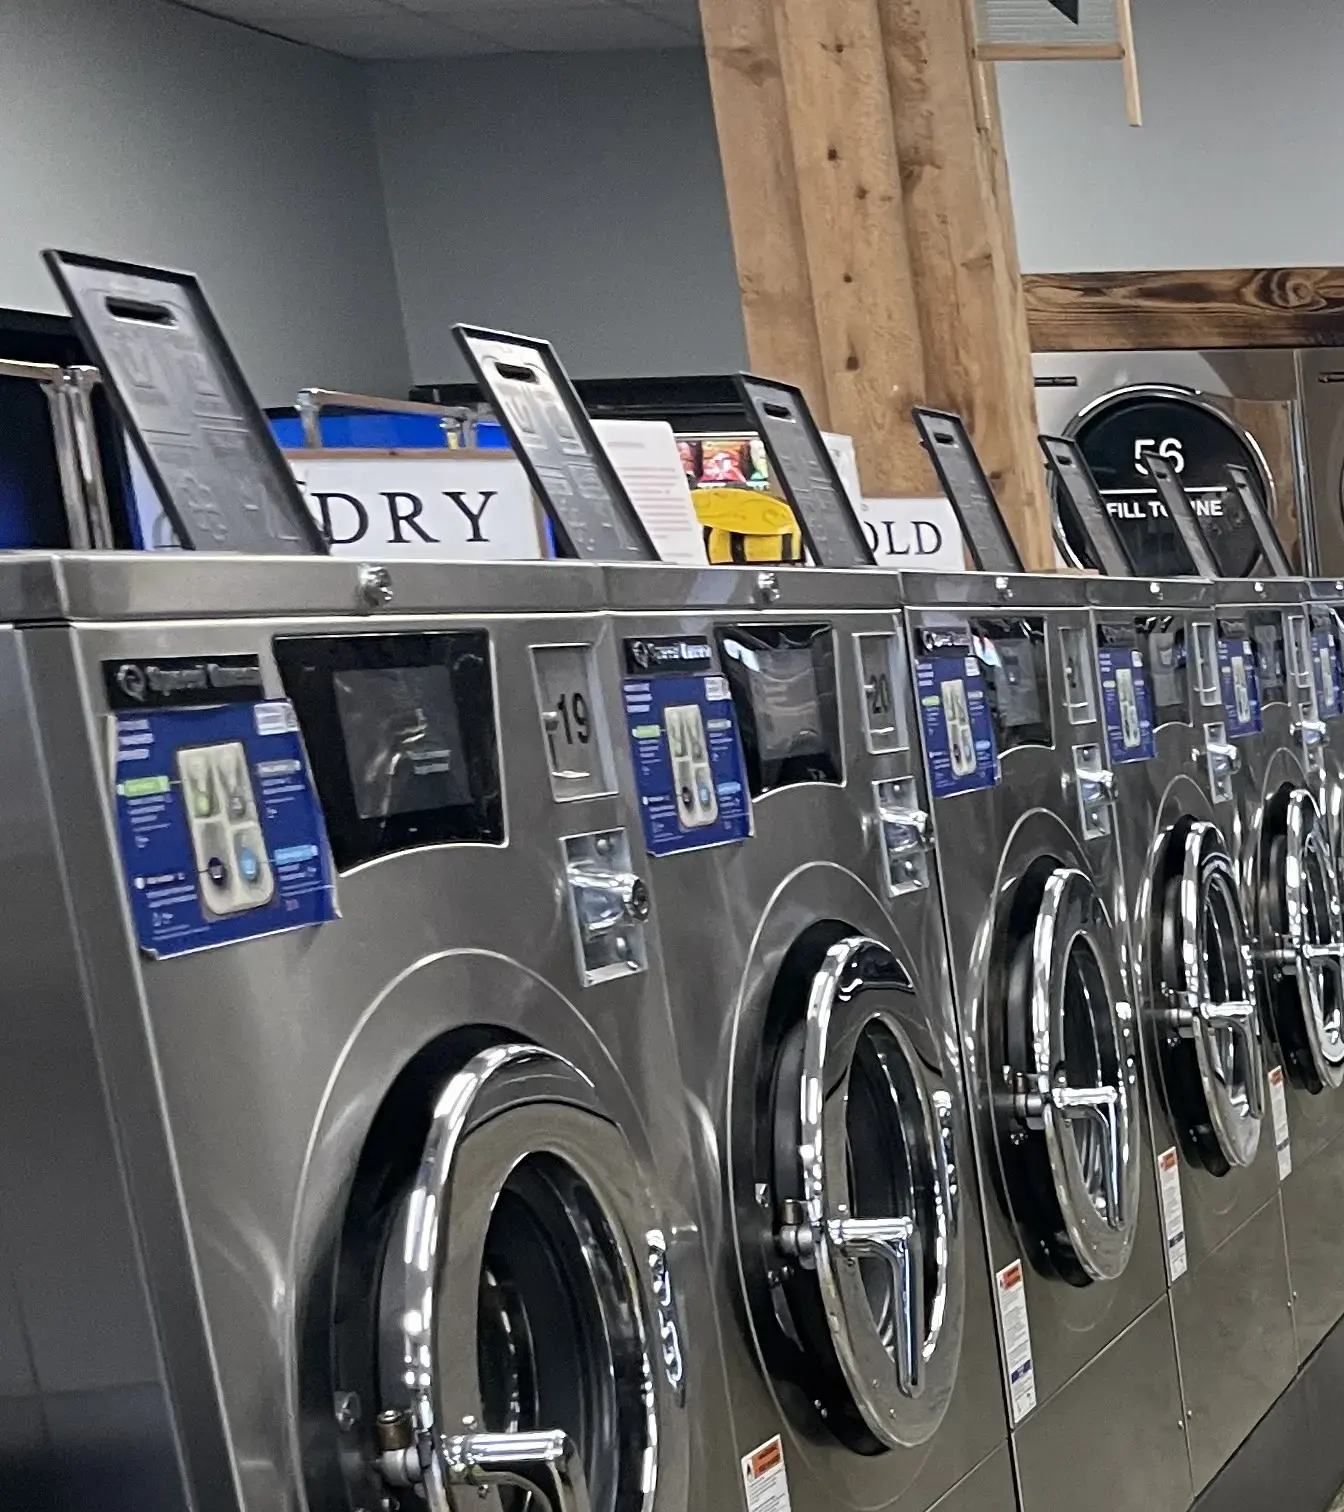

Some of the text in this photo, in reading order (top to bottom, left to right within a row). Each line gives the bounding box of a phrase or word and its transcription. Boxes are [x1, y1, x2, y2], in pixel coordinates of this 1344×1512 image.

[1134, 437, 1185, 476] 56
[310, 490, 498, 545] DRY
[1106, 501, 1146, 519] FILL
[557, 692, 591, 745] 19
